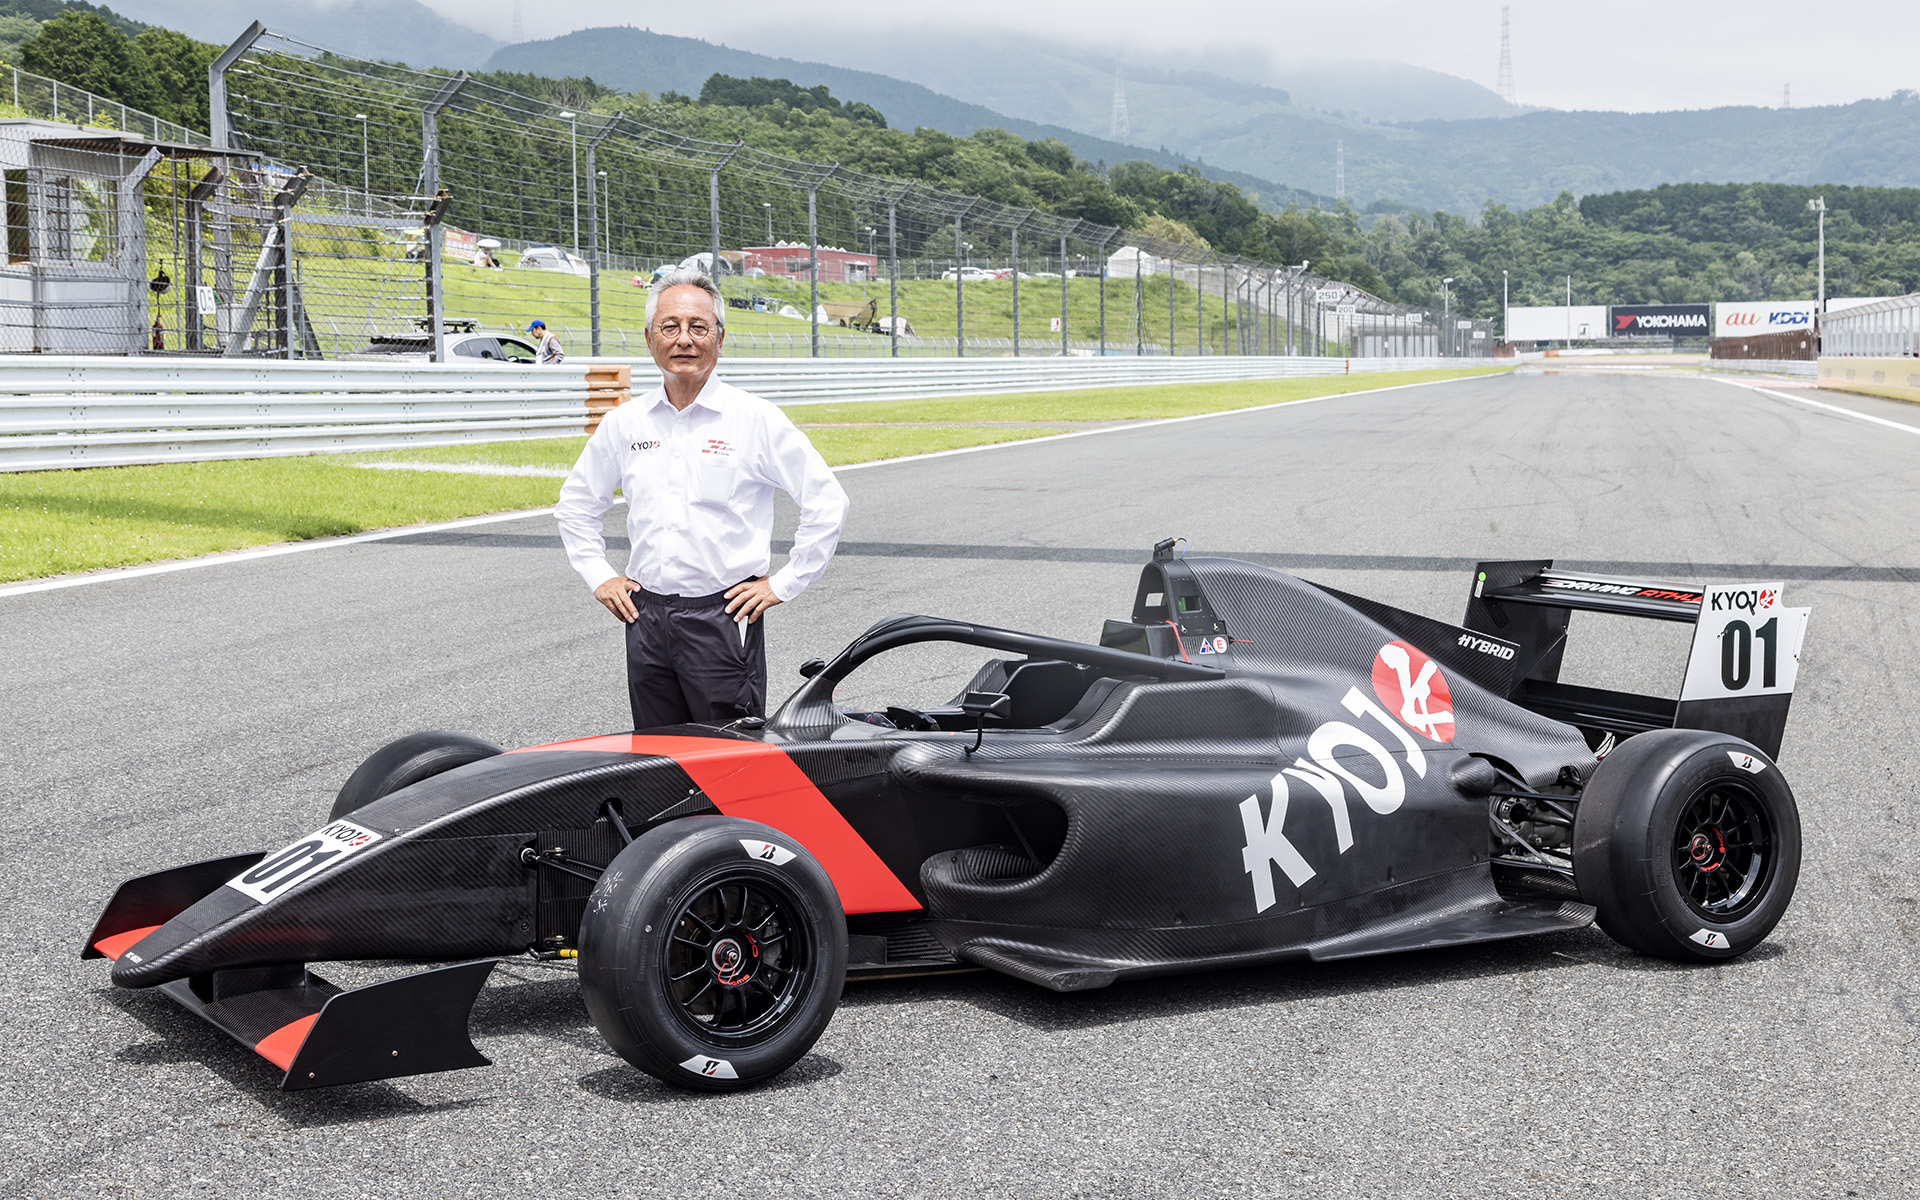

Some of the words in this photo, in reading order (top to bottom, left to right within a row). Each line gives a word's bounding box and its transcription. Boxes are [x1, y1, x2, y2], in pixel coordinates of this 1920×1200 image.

[1318, 292, 1338, 300] 250
[1408, 314, 1421, 322] 150
[1636, 314, 1707, 328] YOKOHAMA
[1726, 312, 1760, 326] au
[1548, 578, 1641, 596] DRIVING
[1216, 640, 1224, 650] E
[1457, 633, 1515, 661] HYBRID
[1721, 617, 1778, 691] 01
[242, 840, 342, 894] 01
